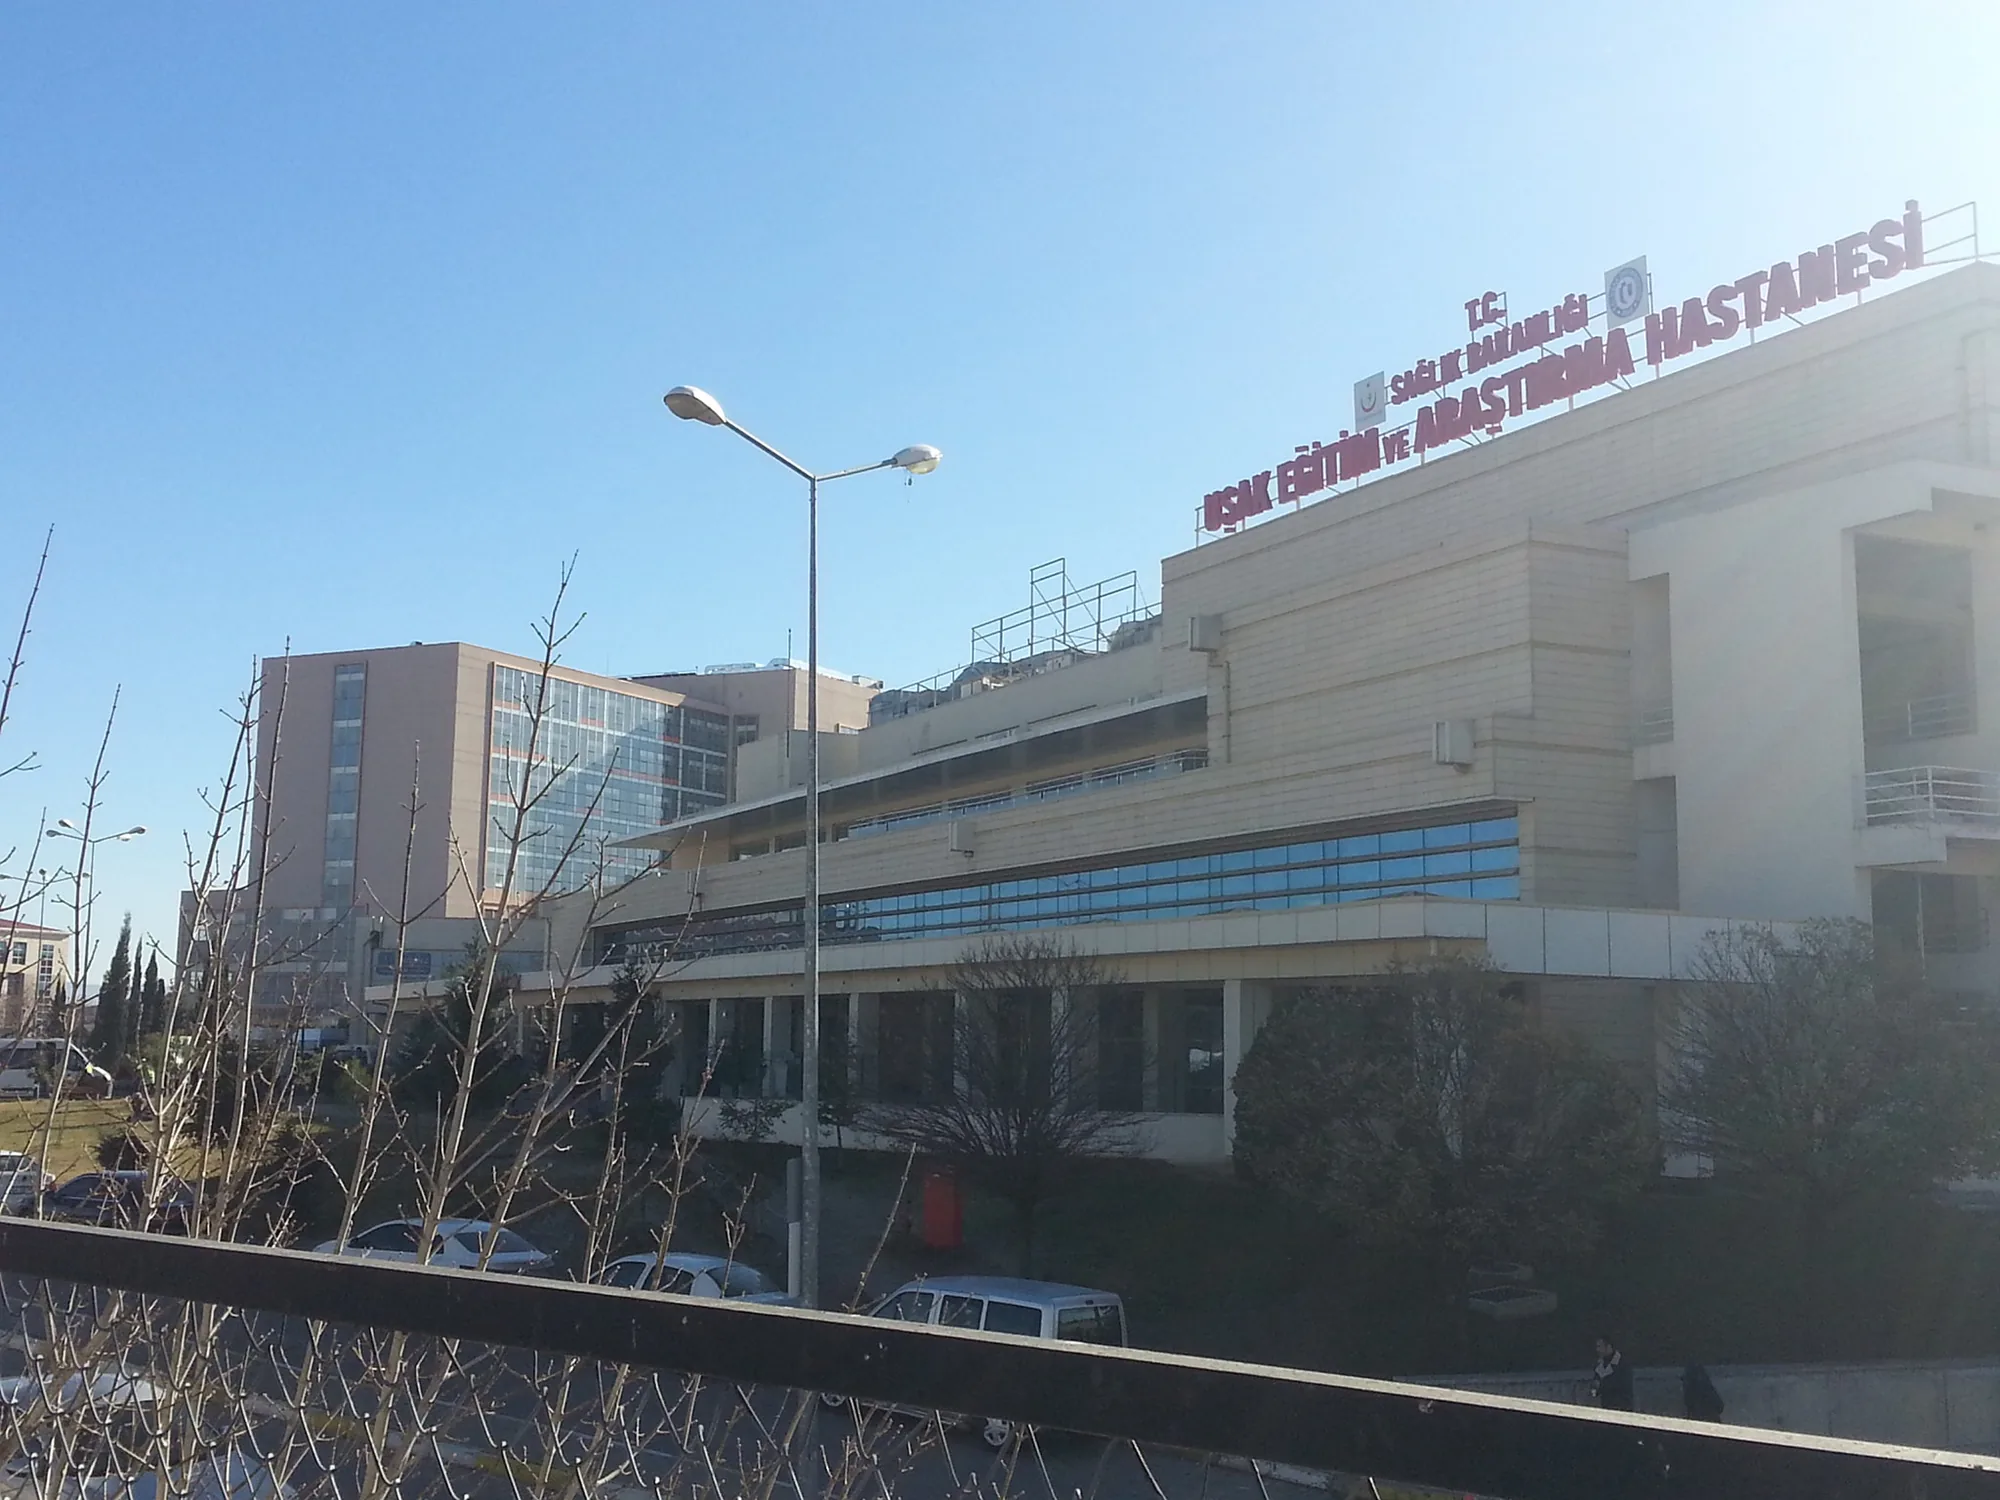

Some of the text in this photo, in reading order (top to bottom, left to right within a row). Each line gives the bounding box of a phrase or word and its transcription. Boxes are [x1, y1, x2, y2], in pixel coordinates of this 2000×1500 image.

[1204, 470, 1273, 533] UŞAK
[1277, 428, 1380, 504] EĞİTİM
[1382, 429, 1410, 465] VE
[1414, 328, 1635, 453] ARAŞTIRMA
[1645, 199, 1924, 366] HASTANESİ
[1391, 294, 1588, 404] SAĞLIK BAKANLIĞI
